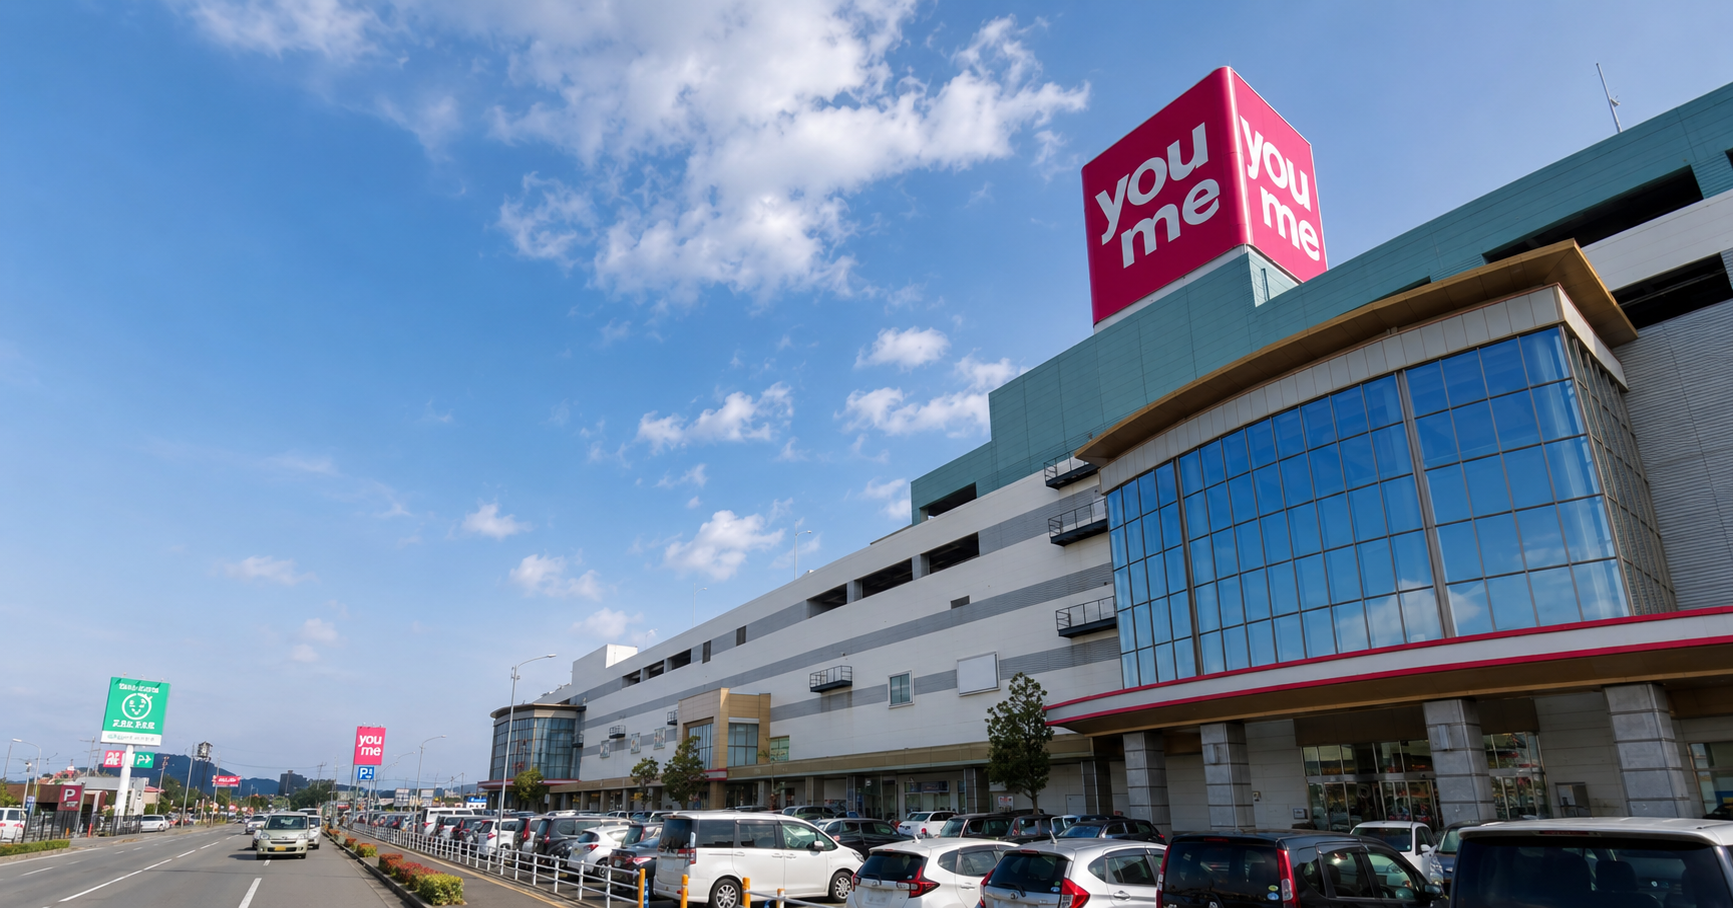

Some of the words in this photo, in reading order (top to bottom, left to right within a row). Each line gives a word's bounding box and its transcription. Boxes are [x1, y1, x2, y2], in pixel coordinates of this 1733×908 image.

[1095, 121, 1209, 246] you
[1239, 115, 1311, 213] you
[1120, 178, 1220, 269] me
[1260, 185, 1320, 262] me
[358, 735, 382, 747] you
[360, 746, 382, 757] me
[63, 788, 76, 802] P
[360, 767, 368, 779] P
